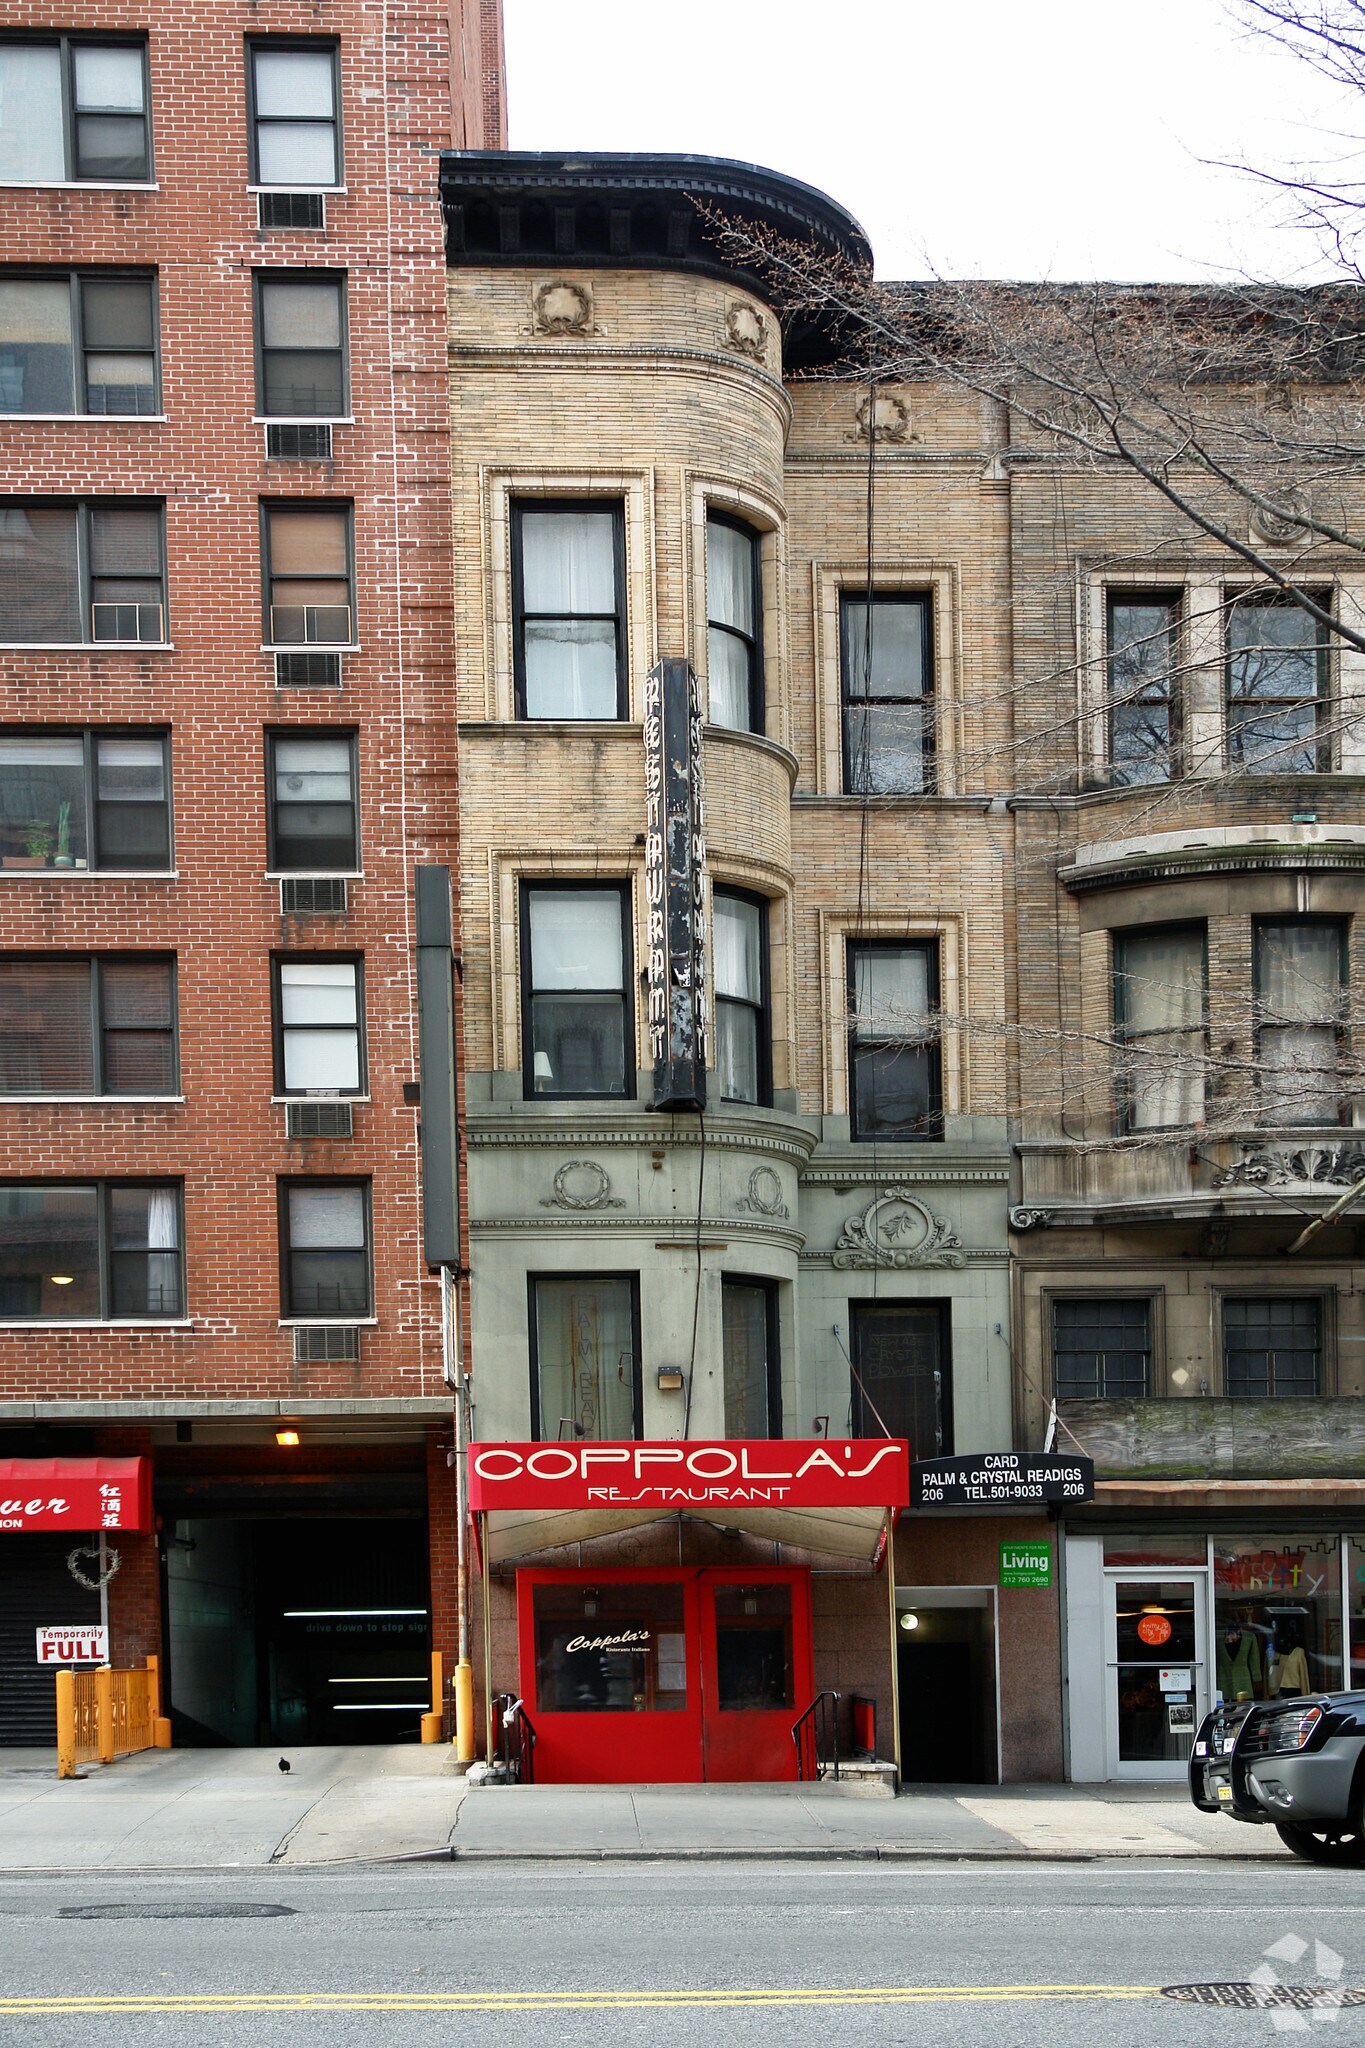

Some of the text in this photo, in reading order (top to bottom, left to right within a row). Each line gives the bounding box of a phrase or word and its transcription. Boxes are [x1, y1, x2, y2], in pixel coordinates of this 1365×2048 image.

[474, 1446, 902, 1480] COPPOLA'S
[984, 1456, 1019, 1468] CARD
[922, 1468, 1082, 1486] PALM & CRYSTAL READIGS
[588, 1486, 791, 1500] RESTAURANT
[922, 1483, 1085, 1500] 206 TEL.501-9033 206
[1002, 1553, 1048, 1571] Living
[41, 1630, 104, 1641] Temporarily
[306, 1624, 332, 1632] drive
[336, 1623, 363, 1632] down
[367, 1624, 377, 1632] to
[382, 1623, 404, 1633] stop
[566, 1630, 651, 1653] Coppola's
[42, 1641, 104, 1661] FULL
